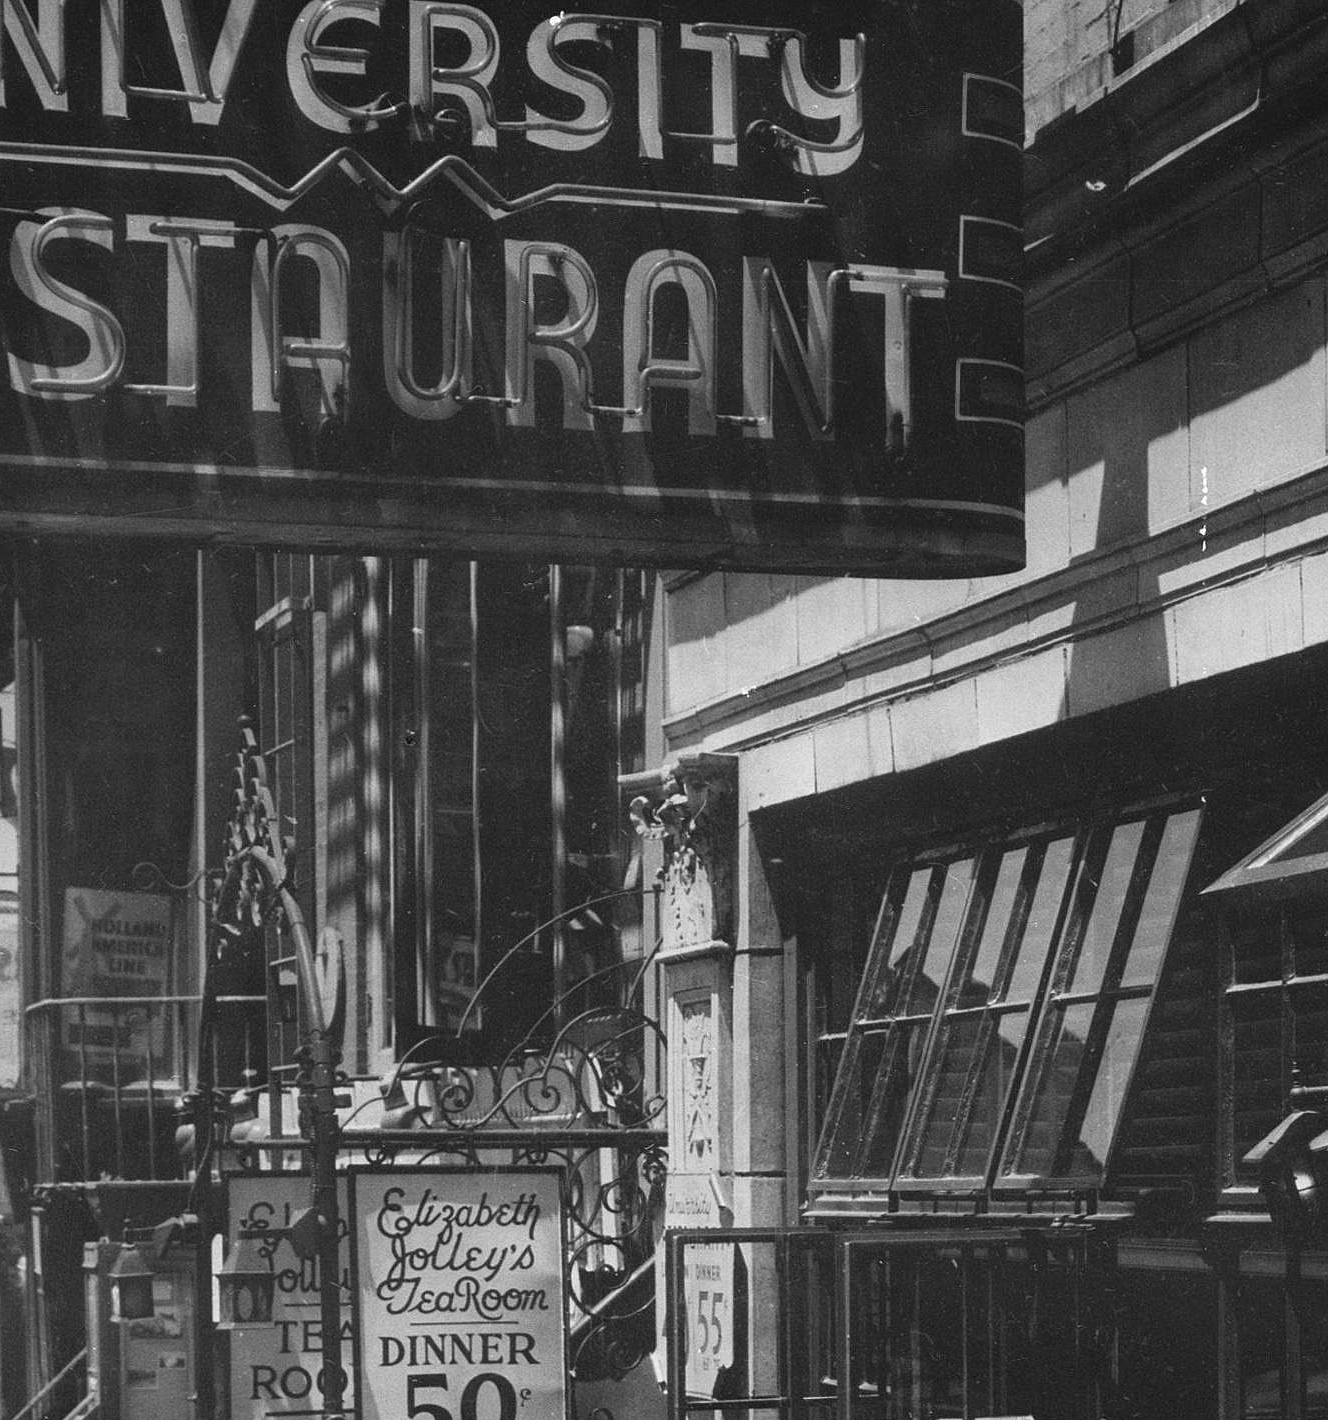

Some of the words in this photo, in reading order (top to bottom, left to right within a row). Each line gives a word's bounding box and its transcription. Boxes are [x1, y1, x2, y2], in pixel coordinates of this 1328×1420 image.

[376, 1186, 541, 1239] Elizabeth
[386, 1233, 536, 1288] Jolley's
[380, 1333, 540, 1368] DINNER
[250, 1365, 349, 1400] ROO
